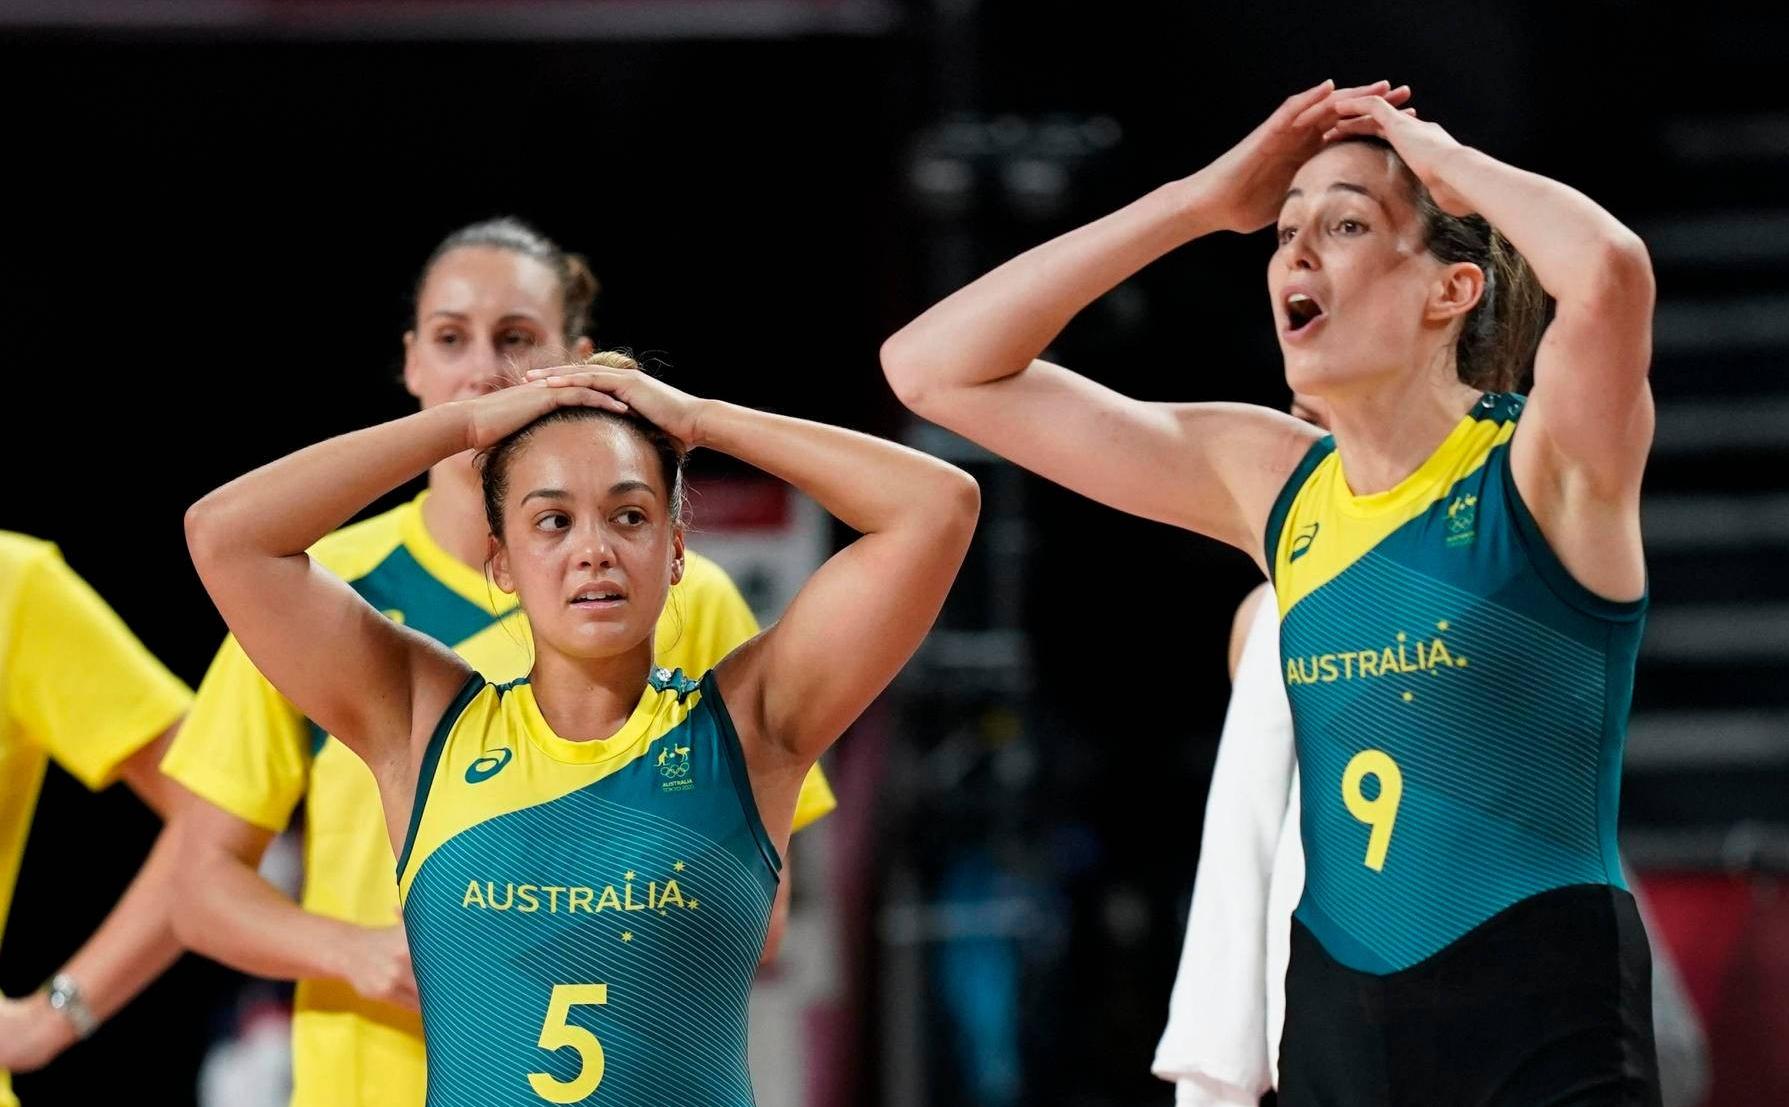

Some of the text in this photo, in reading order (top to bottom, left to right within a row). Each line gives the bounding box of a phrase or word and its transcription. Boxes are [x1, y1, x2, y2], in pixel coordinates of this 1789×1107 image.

[1287, 639, 1453, 685] AUSTRALIA
[662, 779, 693, 787] AUSTRALIA
[1341, 749, 1403, 873] 9
[463, 879, 685, 914] AUSTRALIA
[527, 983, 608, 1104] 5
